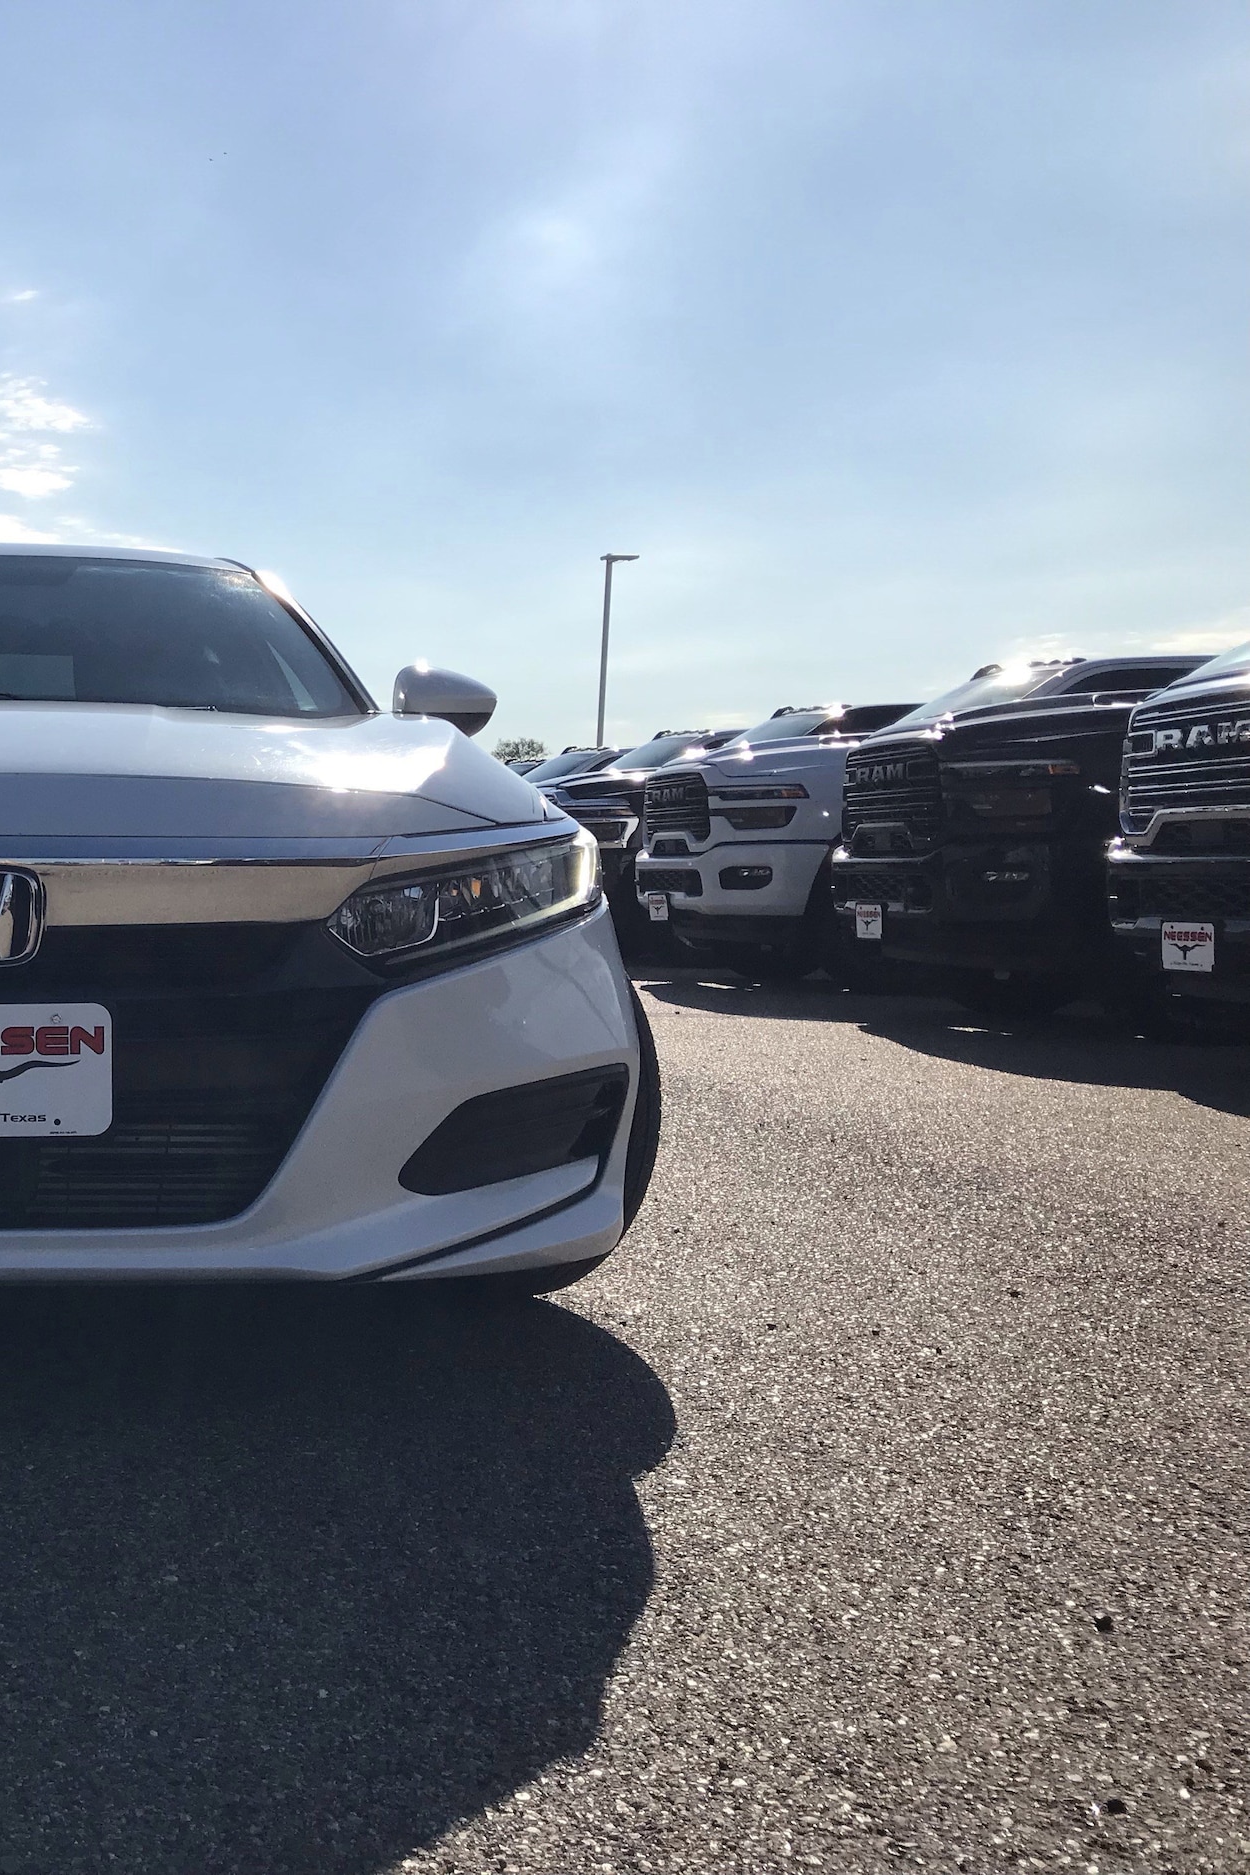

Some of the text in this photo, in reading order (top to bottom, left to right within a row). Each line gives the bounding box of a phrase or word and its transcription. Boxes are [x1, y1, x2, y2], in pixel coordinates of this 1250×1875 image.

[856, 763, 904, 782] RAM
[652, 787, 685, 801] RAM
[1164, 930, 1212, 942] NEESSEN
[0, 1113, 46, 1123] Texas
